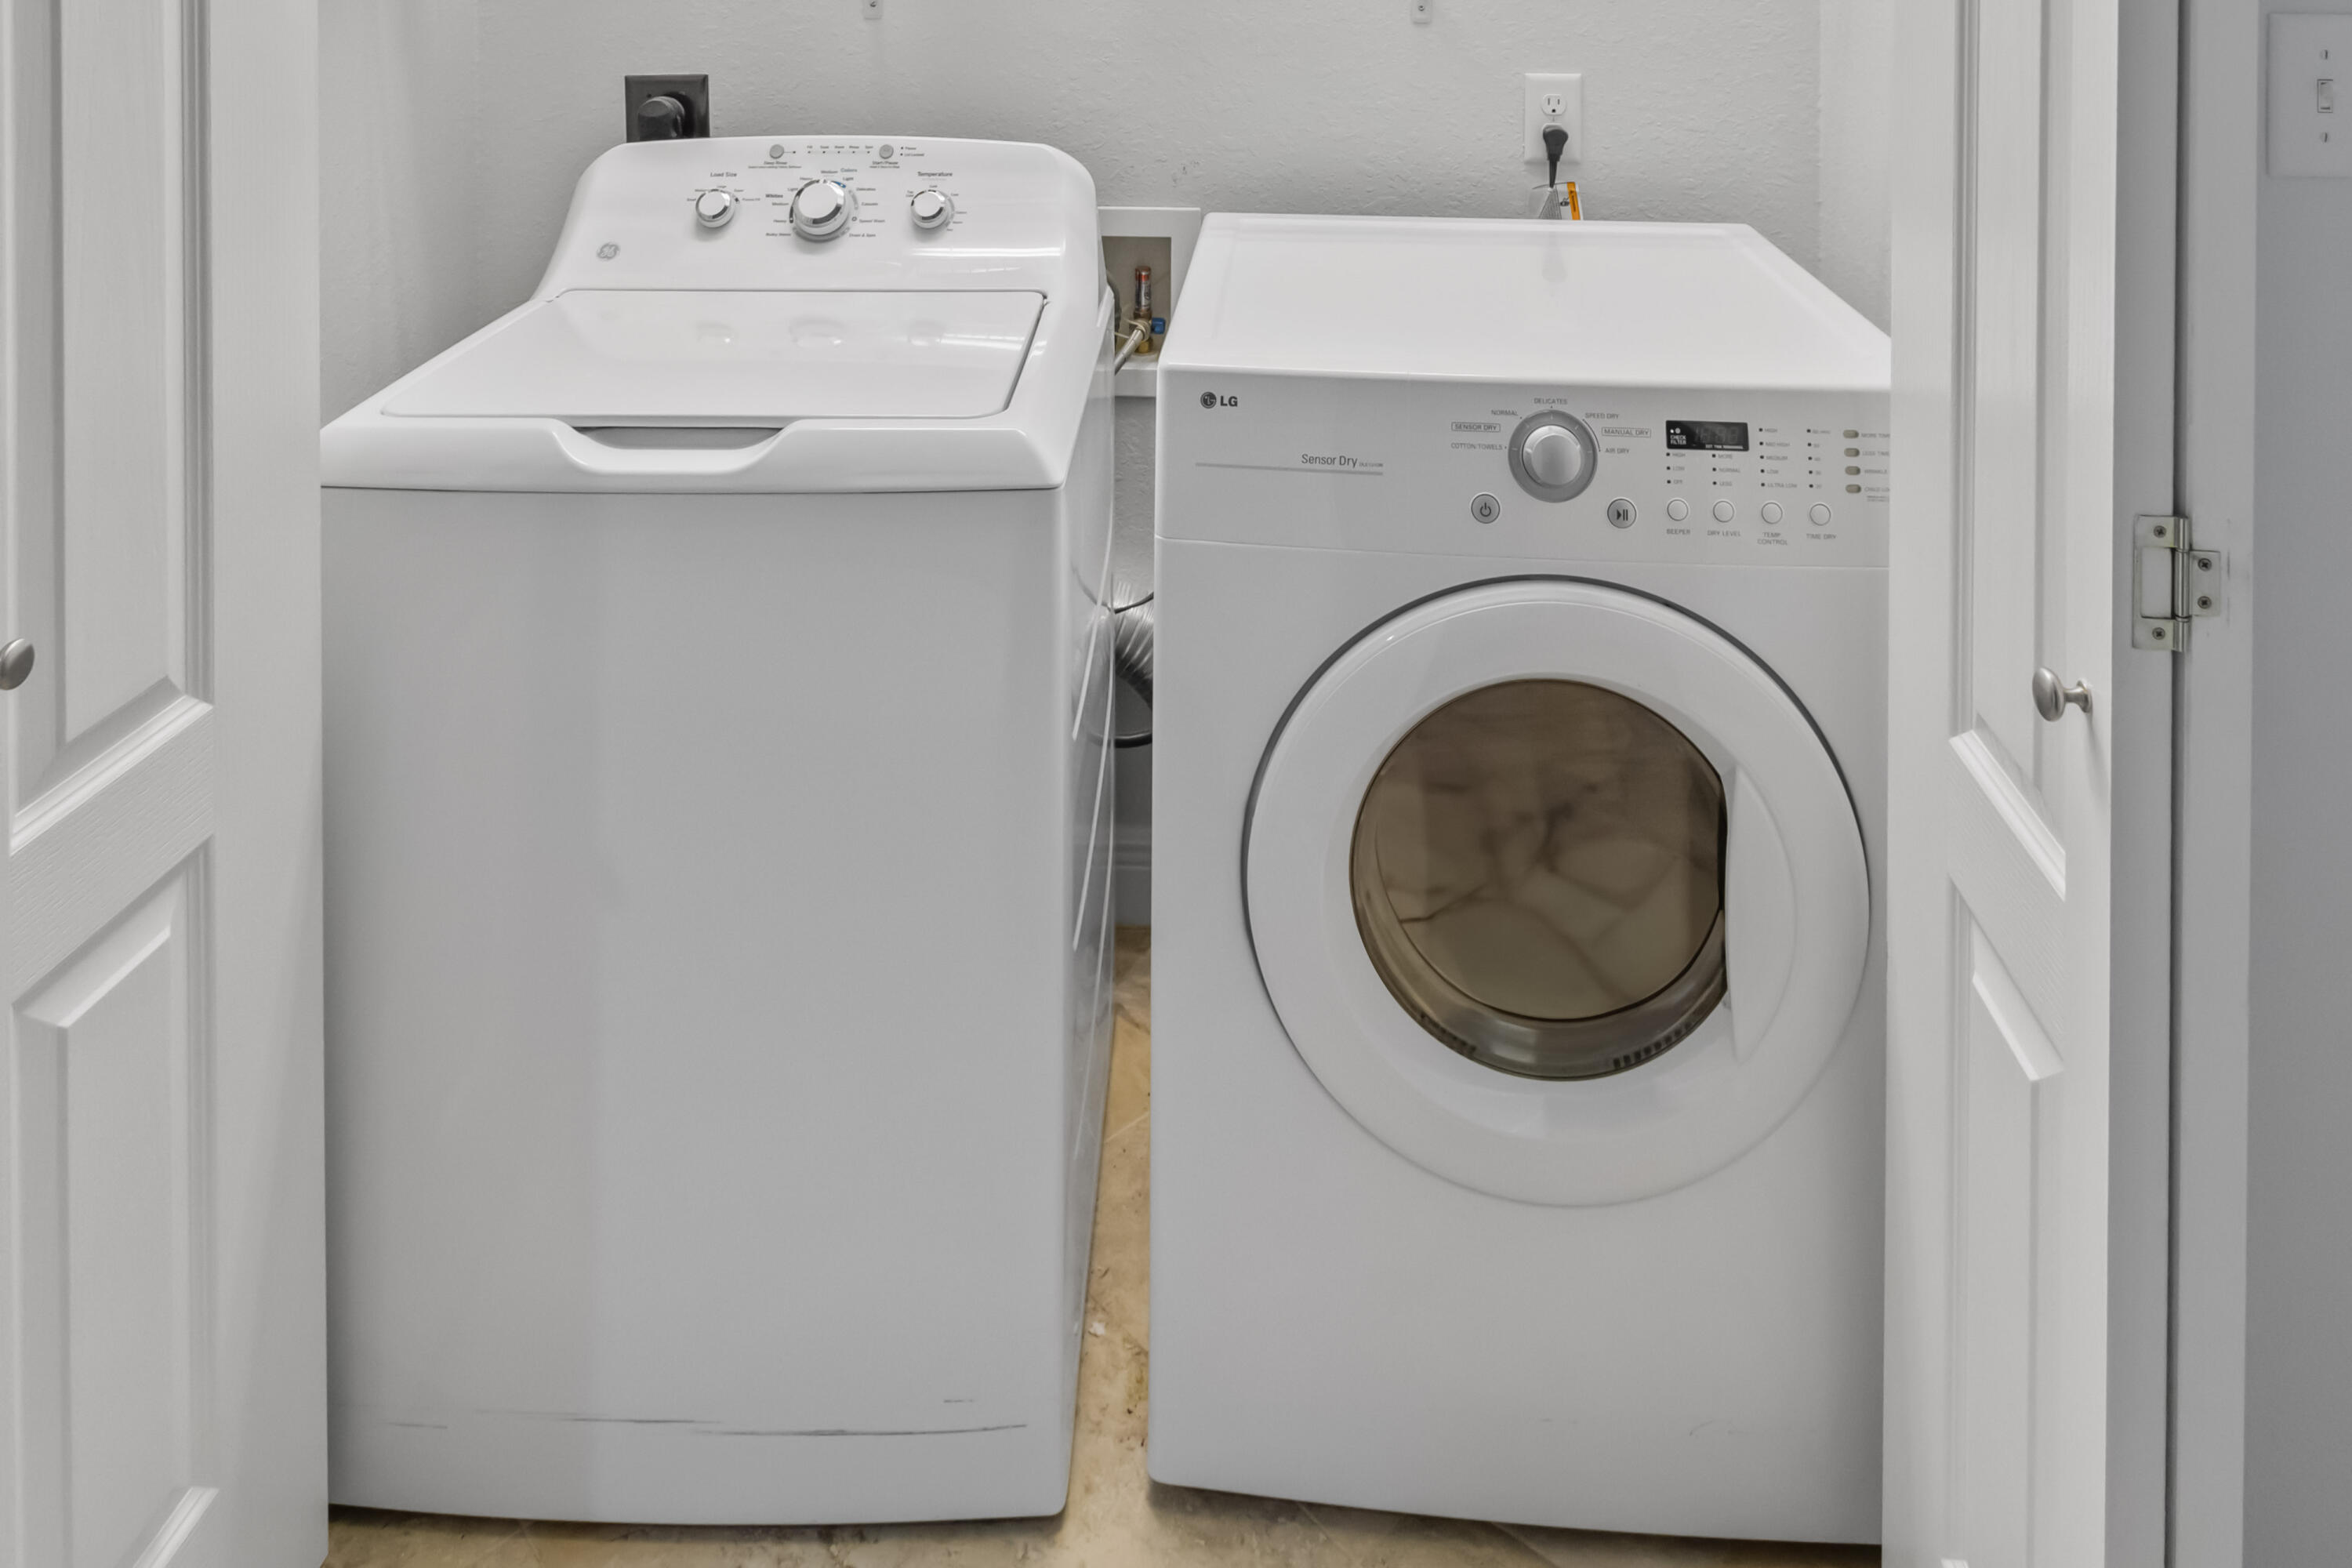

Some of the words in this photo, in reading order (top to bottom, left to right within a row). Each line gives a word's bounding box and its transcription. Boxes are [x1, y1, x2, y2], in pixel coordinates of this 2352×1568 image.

[1220, 395, 1238, 407] LG
[1301, 453, 1336, 466] Sensor
[1339, 455, 1358, 469] Dry
